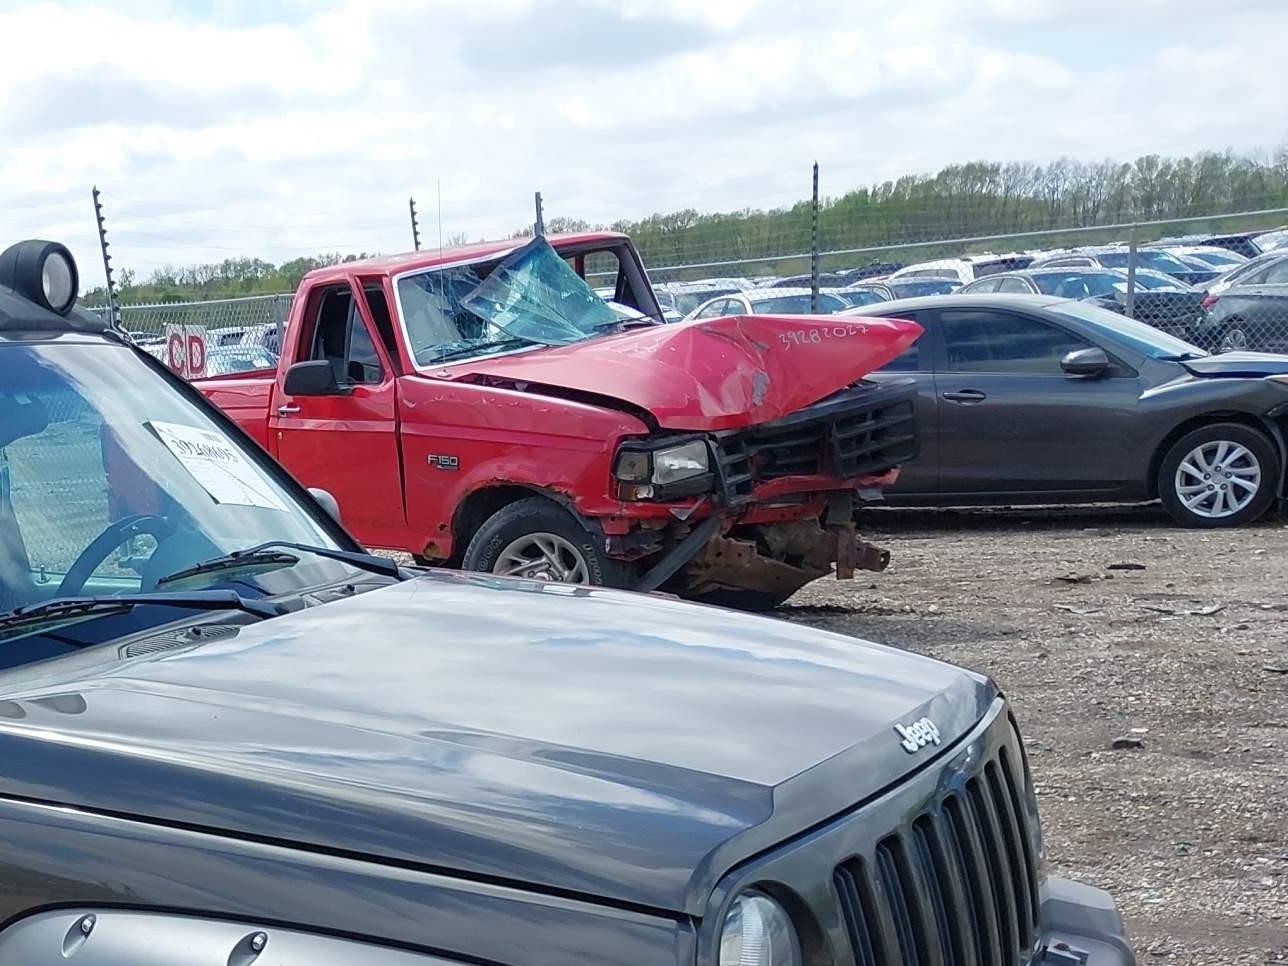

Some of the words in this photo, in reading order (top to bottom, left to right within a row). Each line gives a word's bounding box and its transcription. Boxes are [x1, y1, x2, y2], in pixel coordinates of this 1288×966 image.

[168, 332, 206, 375] CD
[427, 454, 458, 466] F150
[894, 716, 941, 753] Jeep
